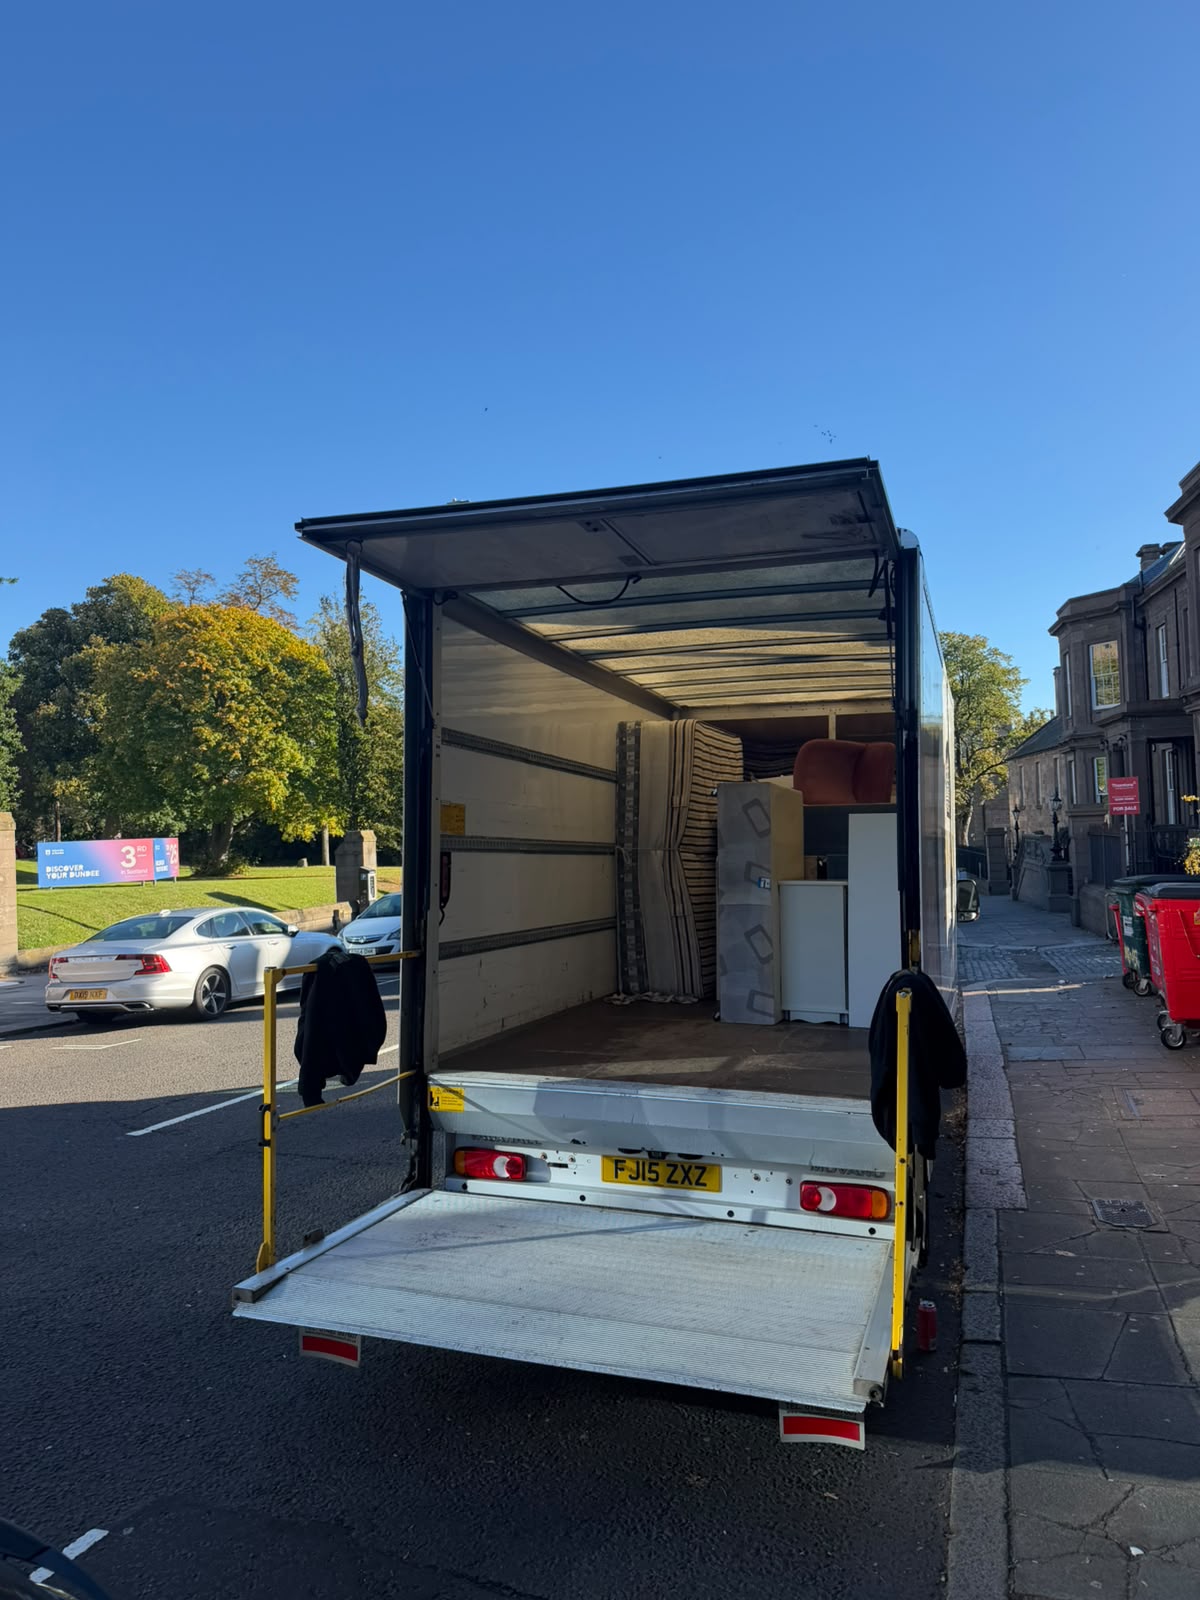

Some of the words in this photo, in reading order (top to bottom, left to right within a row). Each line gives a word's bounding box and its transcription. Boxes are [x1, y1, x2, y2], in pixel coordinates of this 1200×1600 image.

[120, 845, 137, 869] 3
[136, 845, 148, 853] RD
[45, 864, 84, 874] DISCOVER
[46, 872, 68, 880] YOUR
[69, 870, 100, 879] DUNDEE
[614, 1159, 660, 1183] FJ15
[666, 1163, 708, 1188] ZXZ
